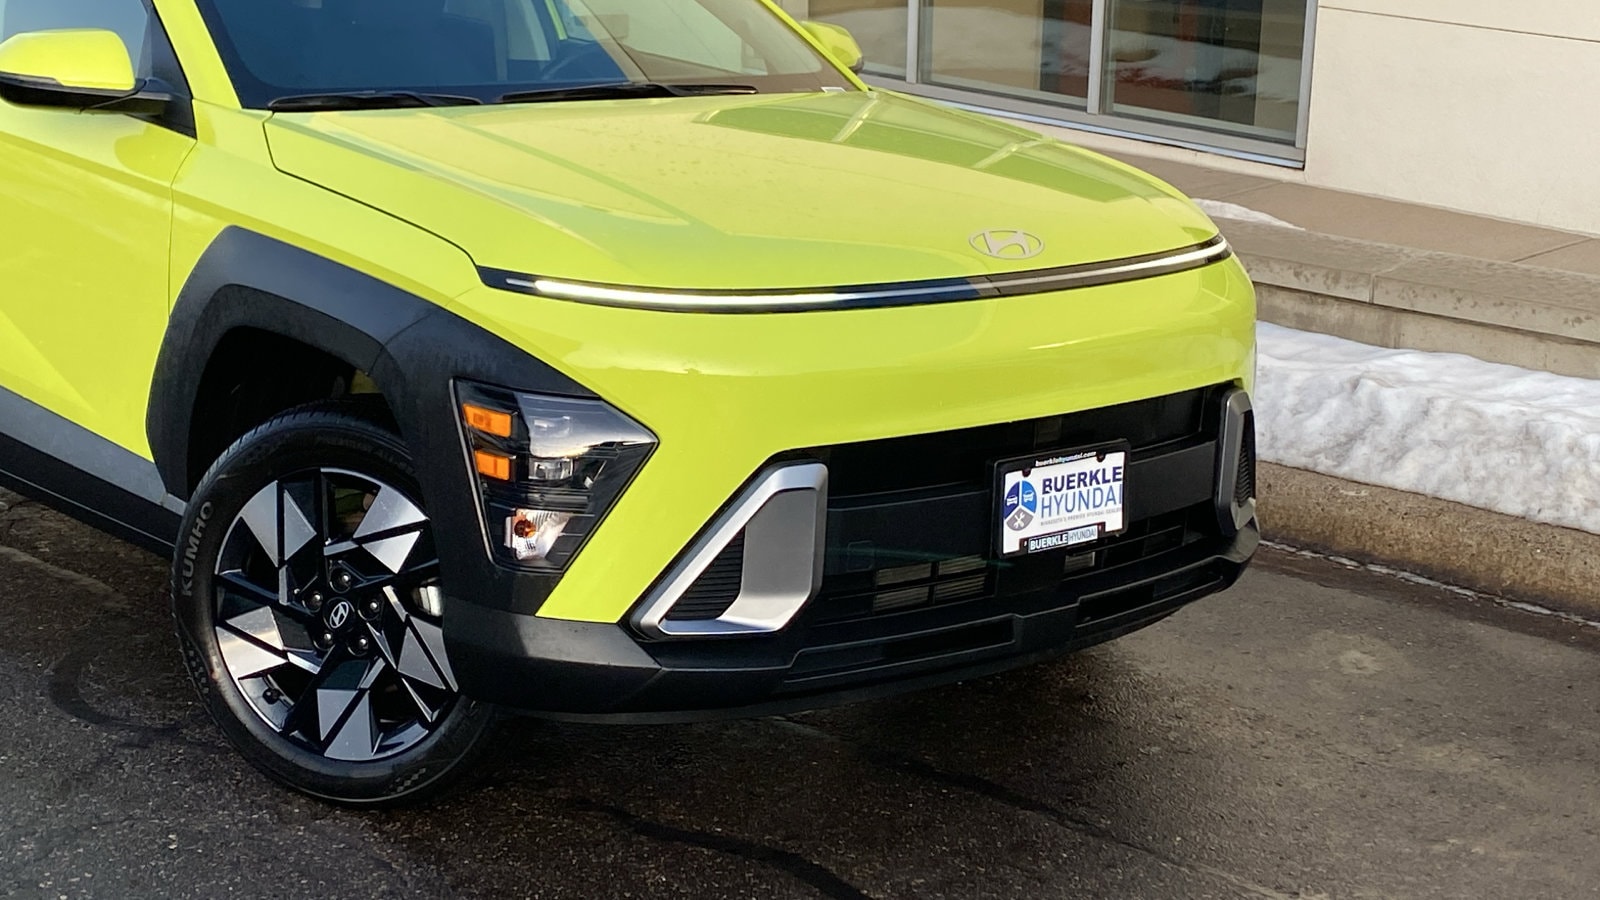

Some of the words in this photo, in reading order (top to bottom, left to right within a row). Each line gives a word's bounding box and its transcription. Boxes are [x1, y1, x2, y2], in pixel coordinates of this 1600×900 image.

[1042, 466, 1123, 495] BUERKLE
[1041, 484, 1123, 518] HYUNDAI
[182, 501, 214, 596] KUMHO
[1029, 533, 1068, 551] BUERKLE
[1069, 527, 1096, 543] HYUNDAI
